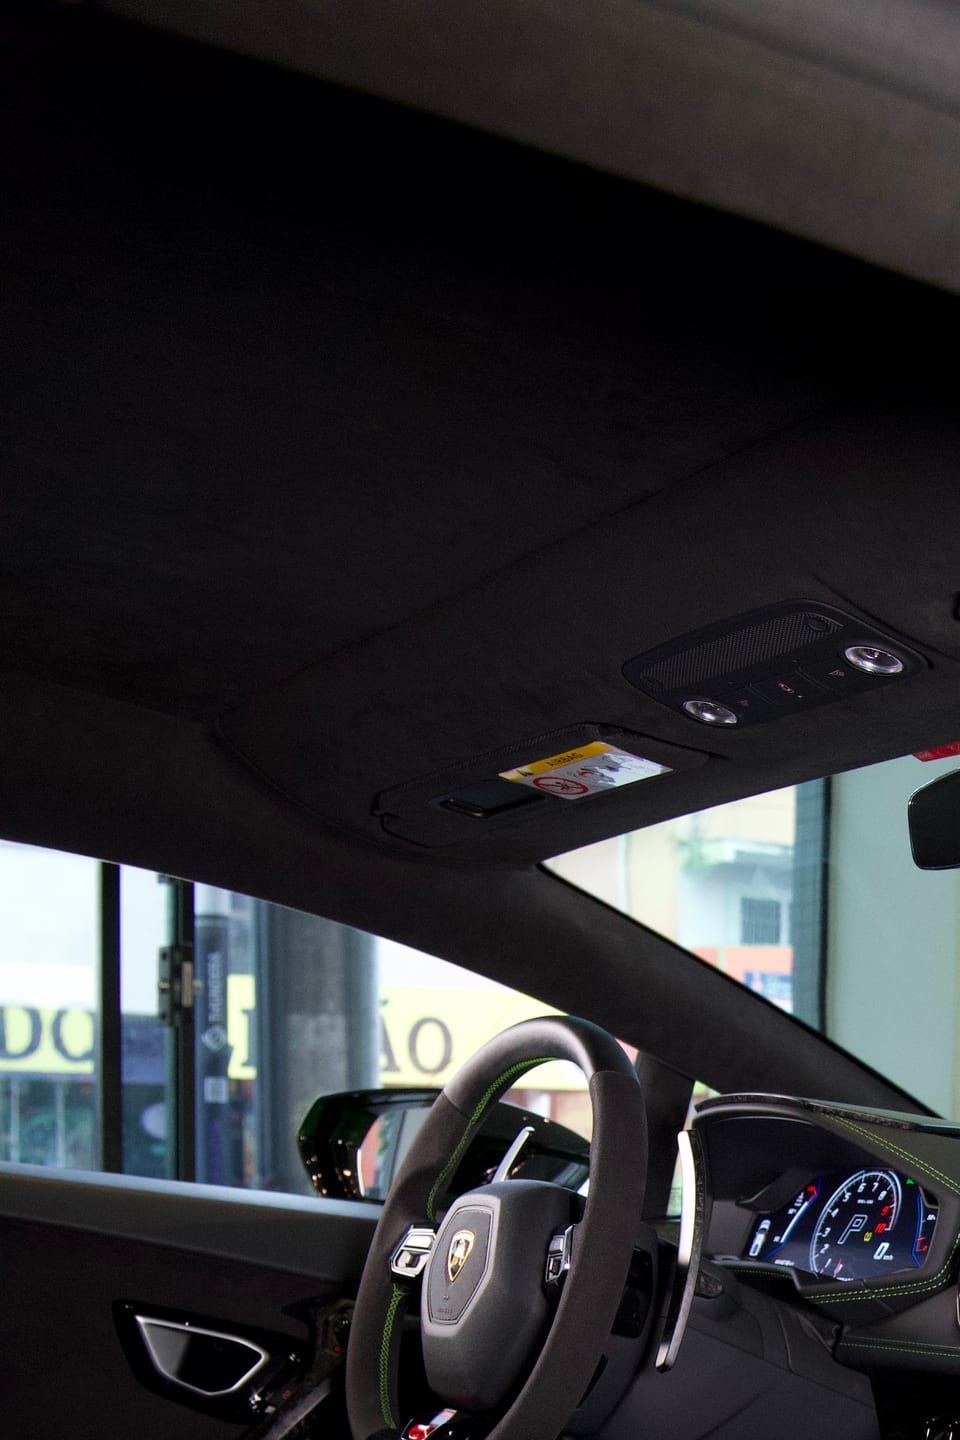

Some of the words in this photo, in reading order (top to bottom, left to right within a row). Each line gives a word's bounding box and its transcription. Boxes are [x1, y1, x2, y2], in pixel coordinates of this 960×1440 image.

[546, 752, 584, 767] AIRBAG
[837, 1214, 868, 1245] P
[873, 1242, 890, 1260] 0
